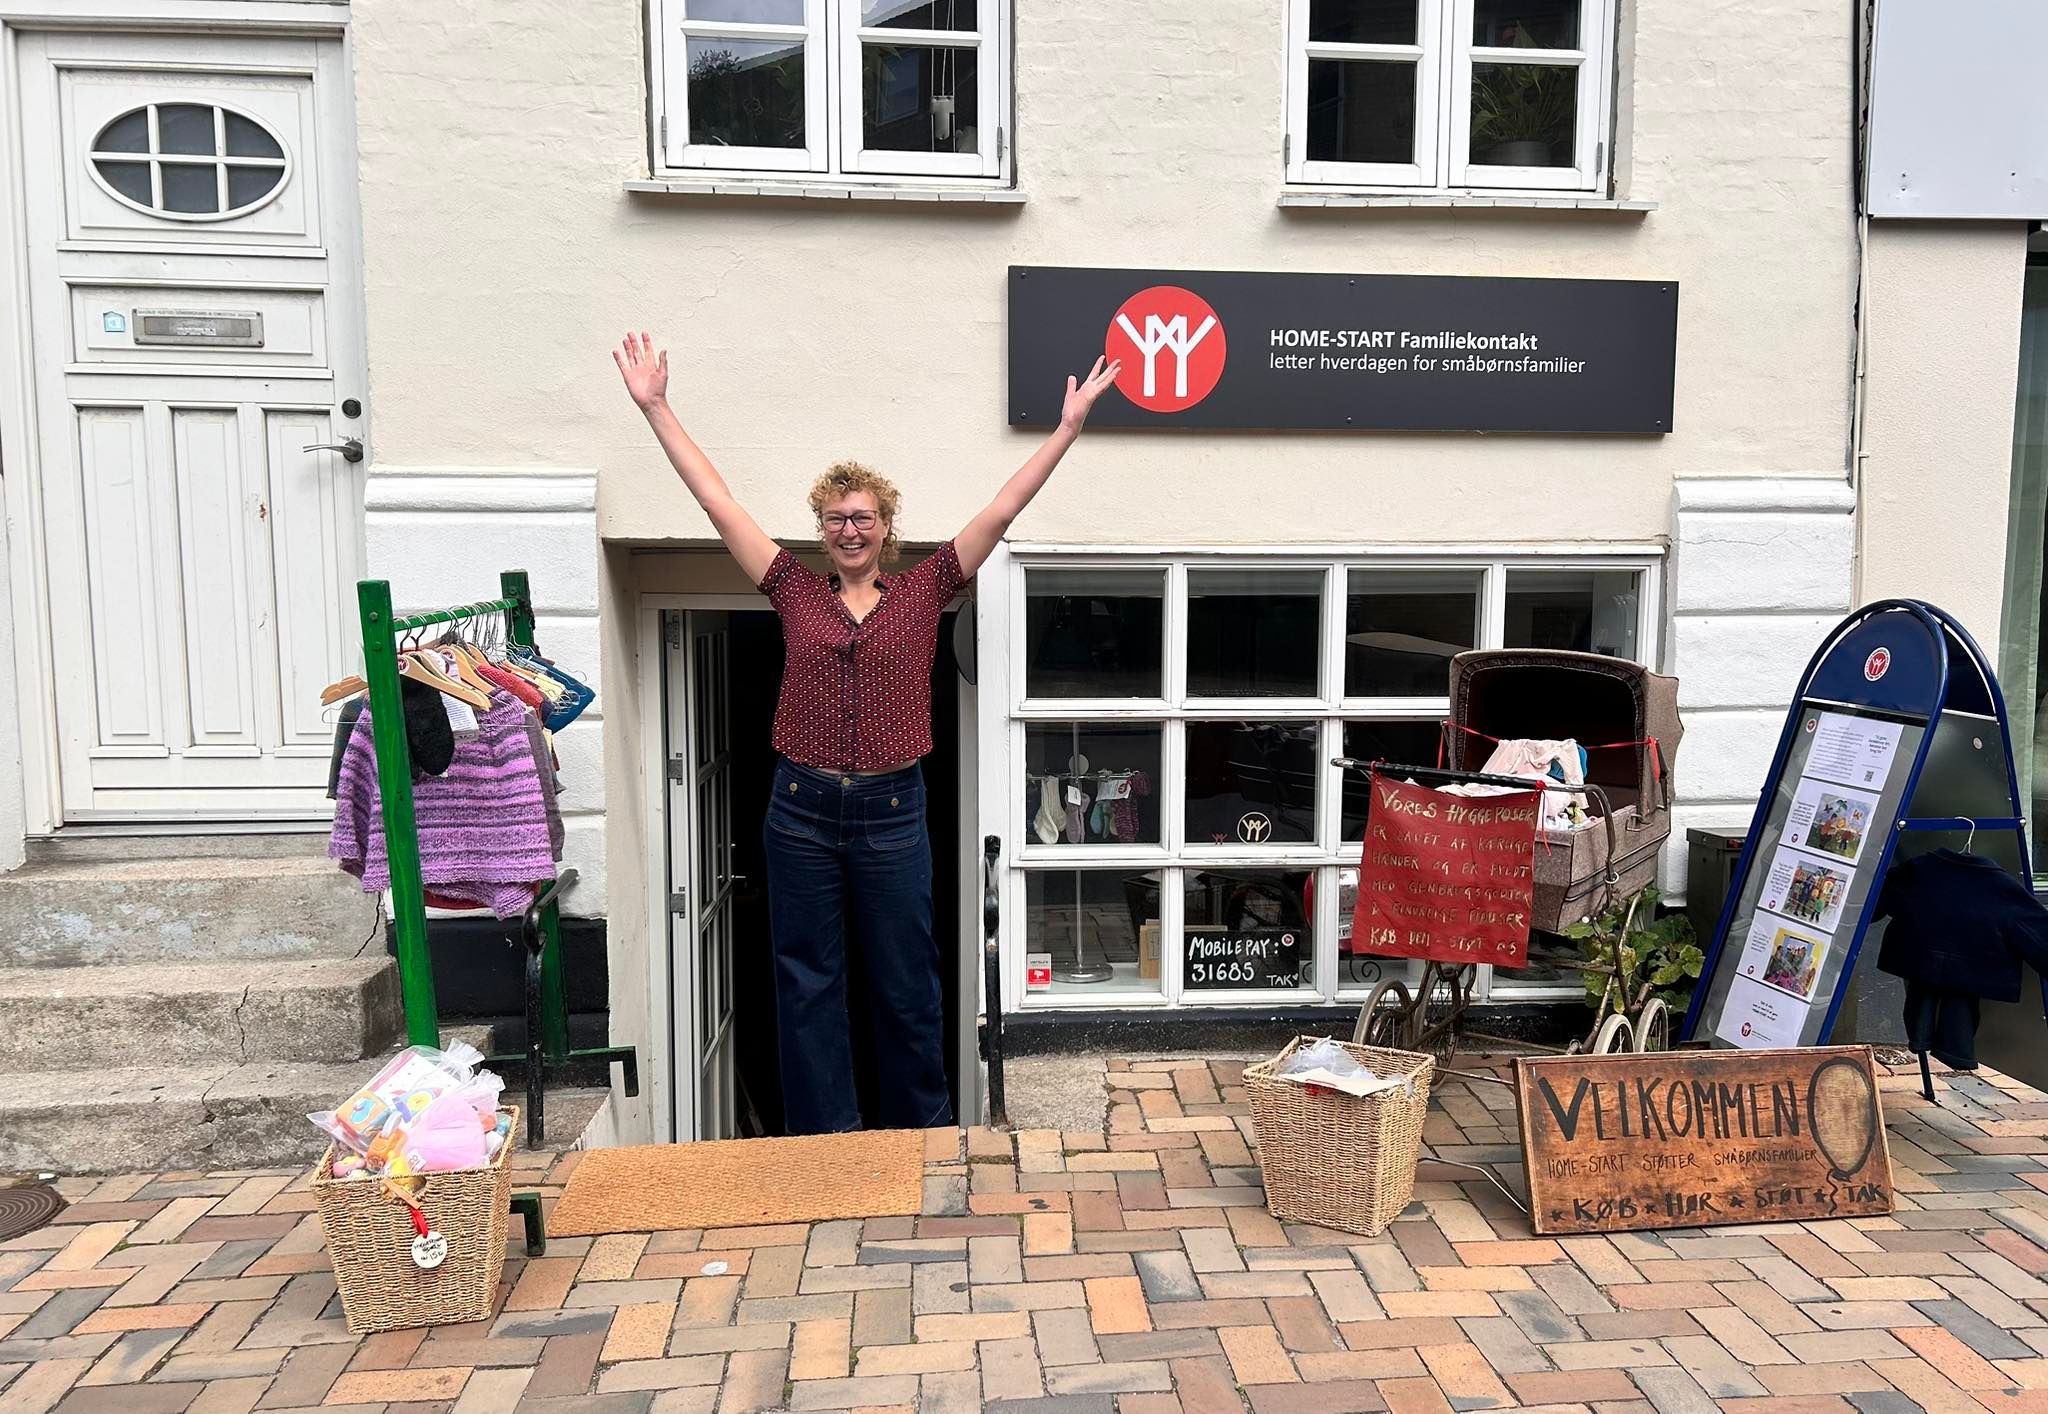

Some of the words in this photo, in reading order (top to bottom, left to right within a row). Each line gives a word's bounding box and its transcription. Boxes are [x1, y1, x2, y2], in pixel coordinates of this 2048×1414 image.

[1270, 329, 1395, 348] HOME-START
[1400, 331, 1538, 350] Familiekontakt
[1270, 352, 1315, 369] letter
[1320, 352, 1408, 374] hverdagen
[1413, 354, 1437, 371] for
[1442, 354, 1585, 373] småbørnsfamilier
[1378, 784, 1437, 818] VORES
[1191, 961, 1255, 982] 31685
[1266, 974, 1294, 987] TAK
[1538, 1076, 1800, 1142] VELKOMMEN
[1548, 1152, 1628, 1179] HOME-START
[1642, 1152, 1701, 1174] STØTTER
[1572, 1197, 1638, 1223] KØB
[1754, 1186, 1811, 1209] STØT
[1847, 1182, 1890, 1203] TAK
